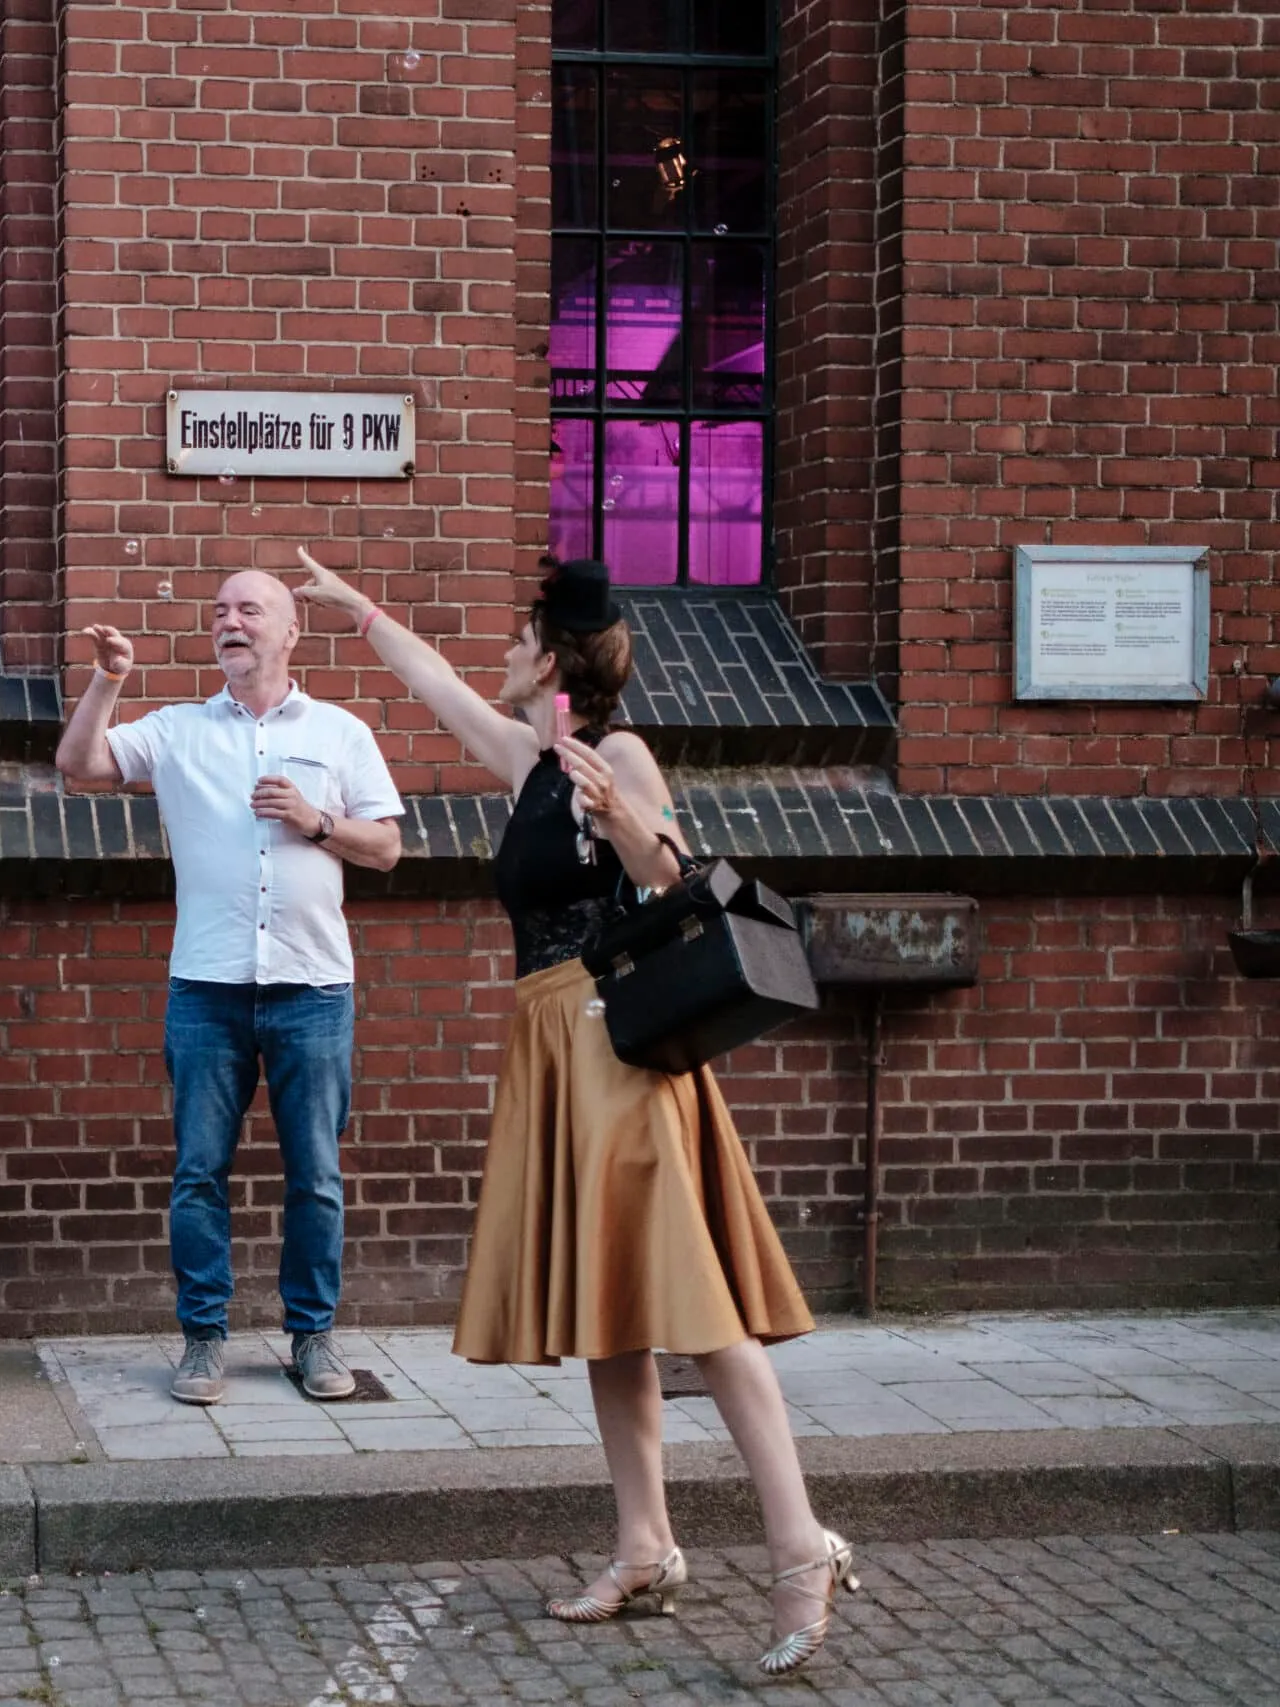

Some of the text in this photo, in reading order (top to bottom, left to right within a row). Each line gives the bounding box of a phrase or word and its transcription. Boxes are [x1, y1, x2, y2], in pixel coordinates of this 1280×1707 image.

[181, 410, 302, 454] Einstellplätze
[310, 413, 335, 450] für
[362, 413, 401, 451] PKW
